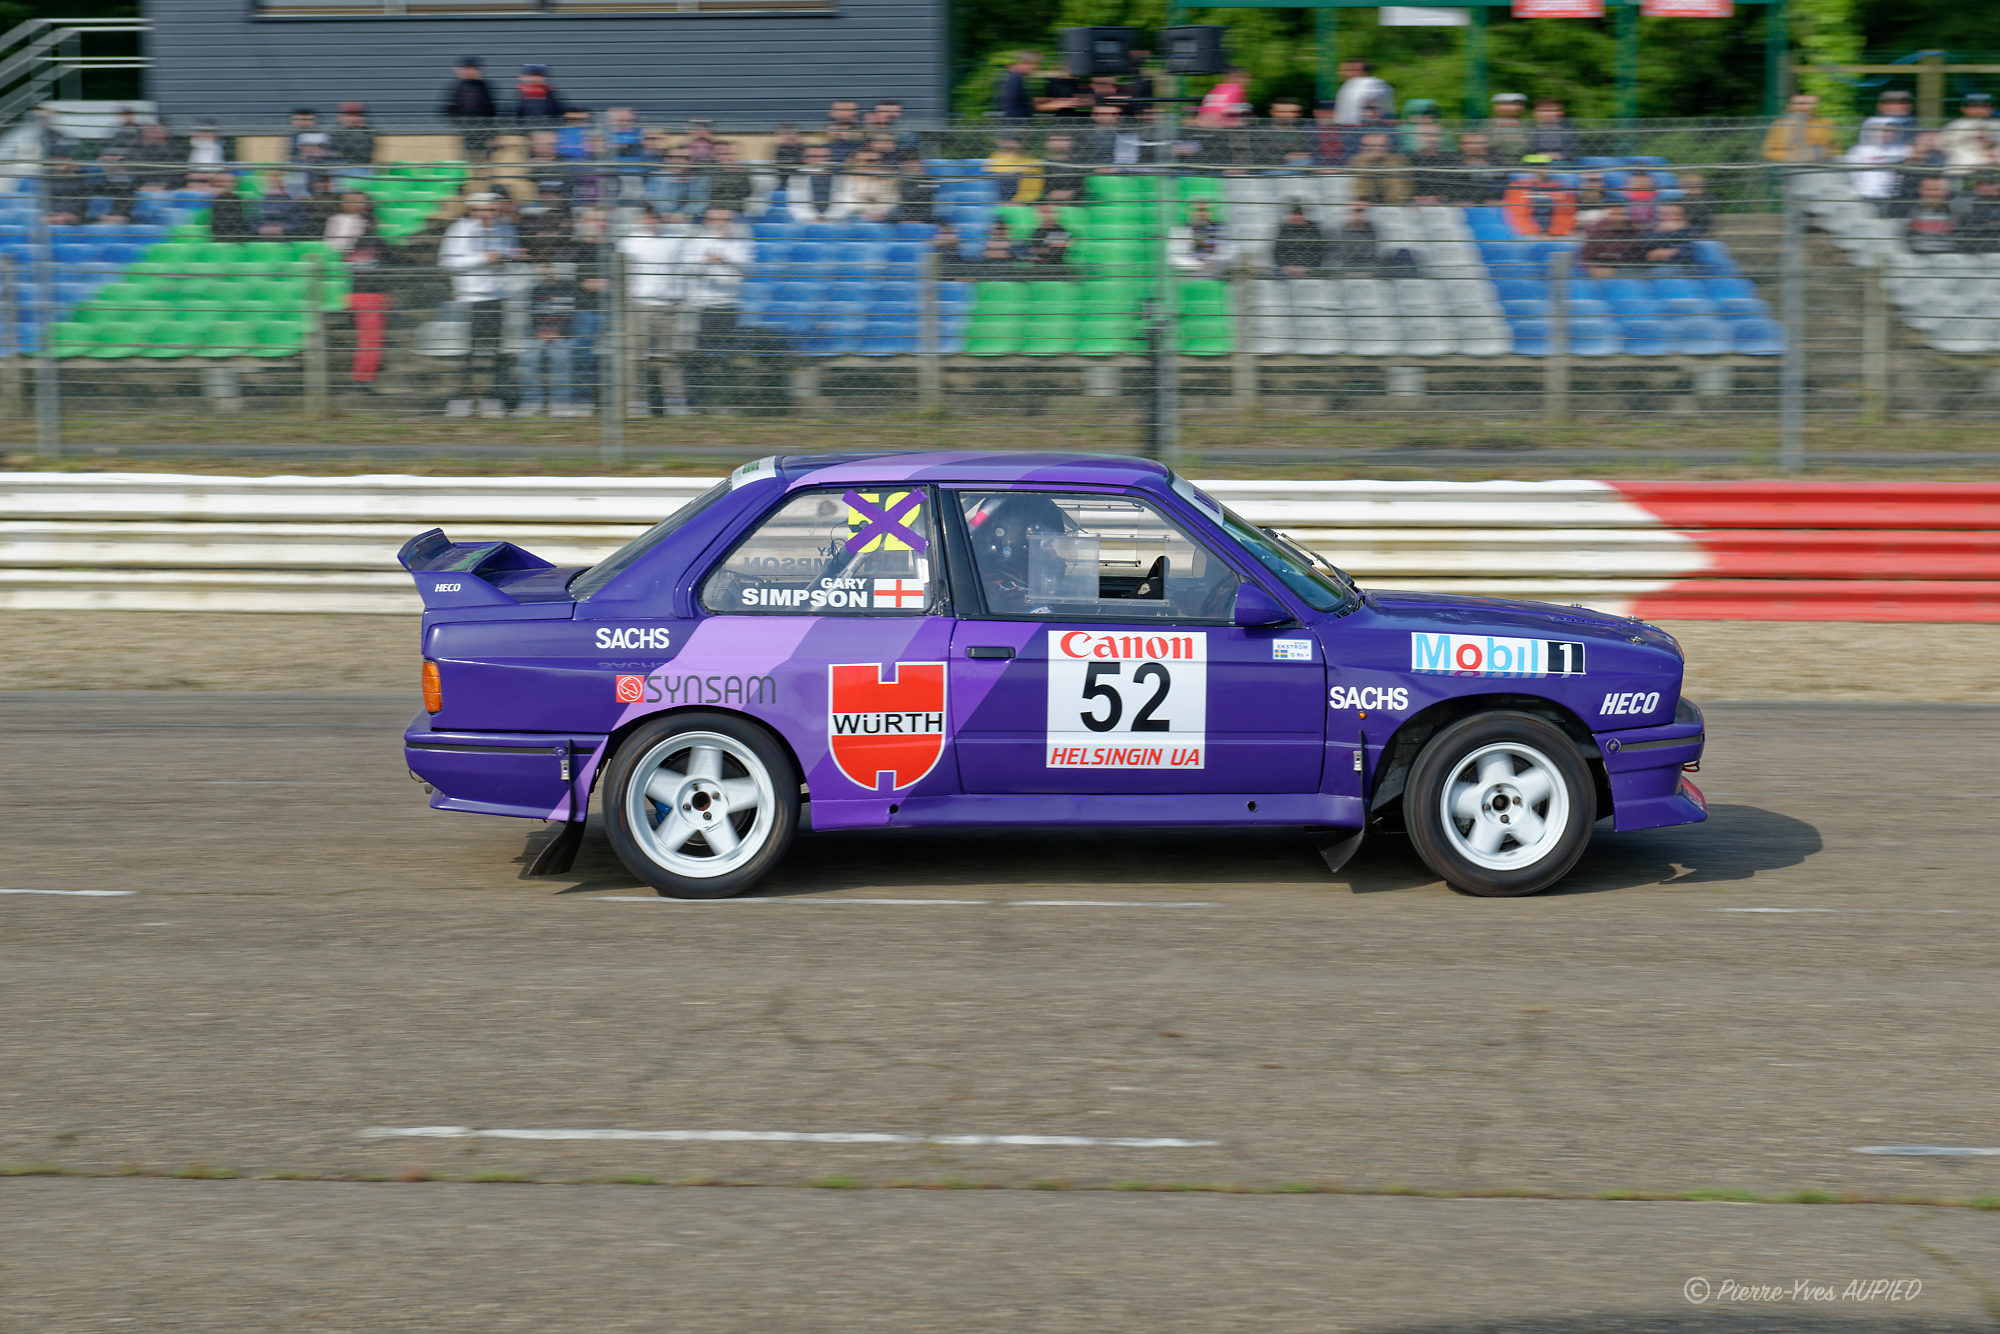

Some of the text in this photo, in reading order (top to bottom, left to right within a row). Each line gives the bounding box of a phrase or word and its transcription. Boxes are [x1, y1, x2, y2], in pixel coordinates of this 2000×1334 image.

[435, 583, 461, 592] HECO
[820, 577, 867, 590] GARY
[741, 588, 868, 608] SIMPSON
[595, 627, 670, 649] SACHS
[1060, 631, 1193, 659] Canon
[1415, 633, 1575, 673] Mobil 1
[646, 675, 776, 704] SYNSAM
[1080, 661, 1171, 733] 52
[1329, 686, 1409, 711] SACHS
[1600, 691, 1660, 716] HECO
[832, 712, 943, 735] WÜRTH
[1050, 747, 1200, 766] HELSINGIN UA
